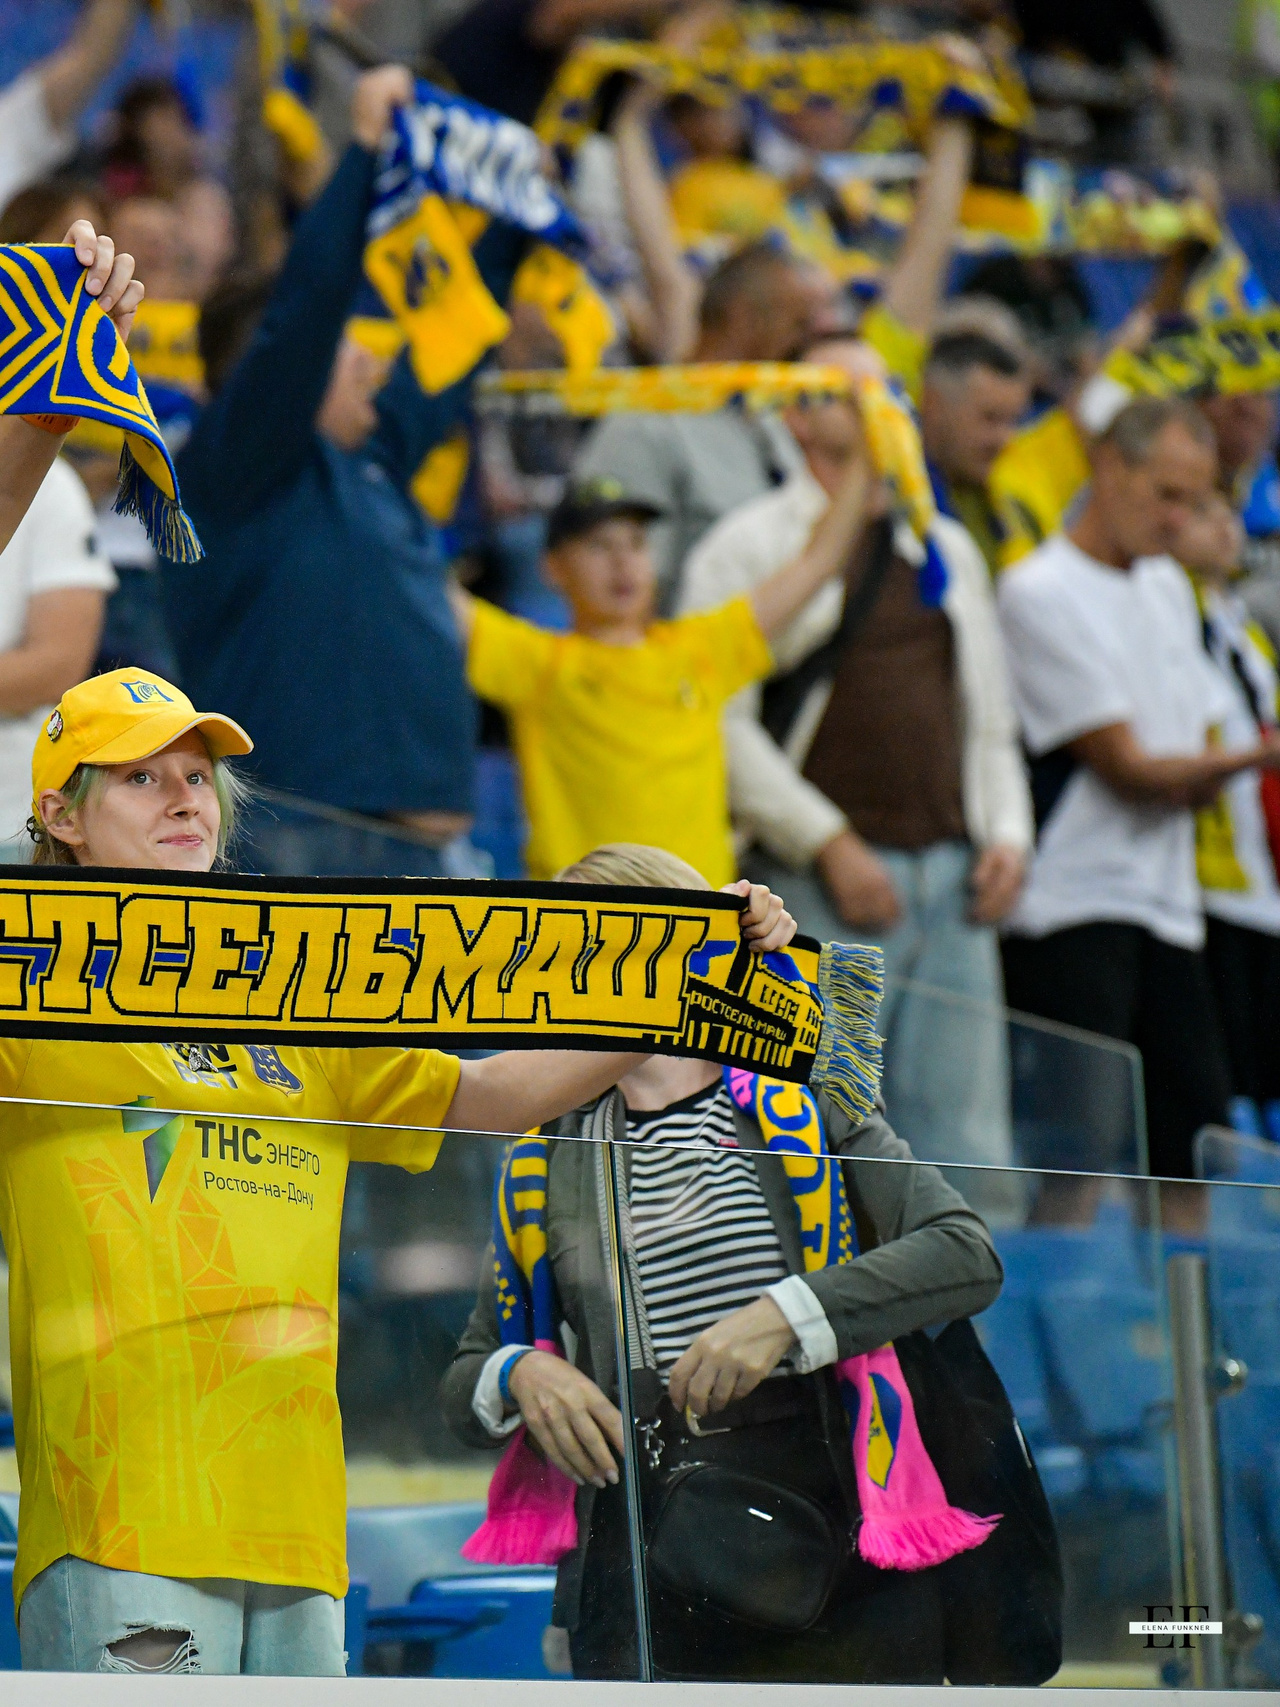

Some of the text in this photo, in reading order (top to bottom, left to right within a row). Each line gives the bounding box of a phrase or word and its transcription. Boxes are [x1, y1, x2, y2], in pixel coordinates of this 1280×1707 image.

[689, 990, 787, 1040] РОСТСЕЛЬМАШ
[172, 1060, 238, 1089] BET
[194, 1119, 320, 1175] ТНС ЭНЕРГО
[203, 1171, 314, 1210] Ростов-на-Дону
